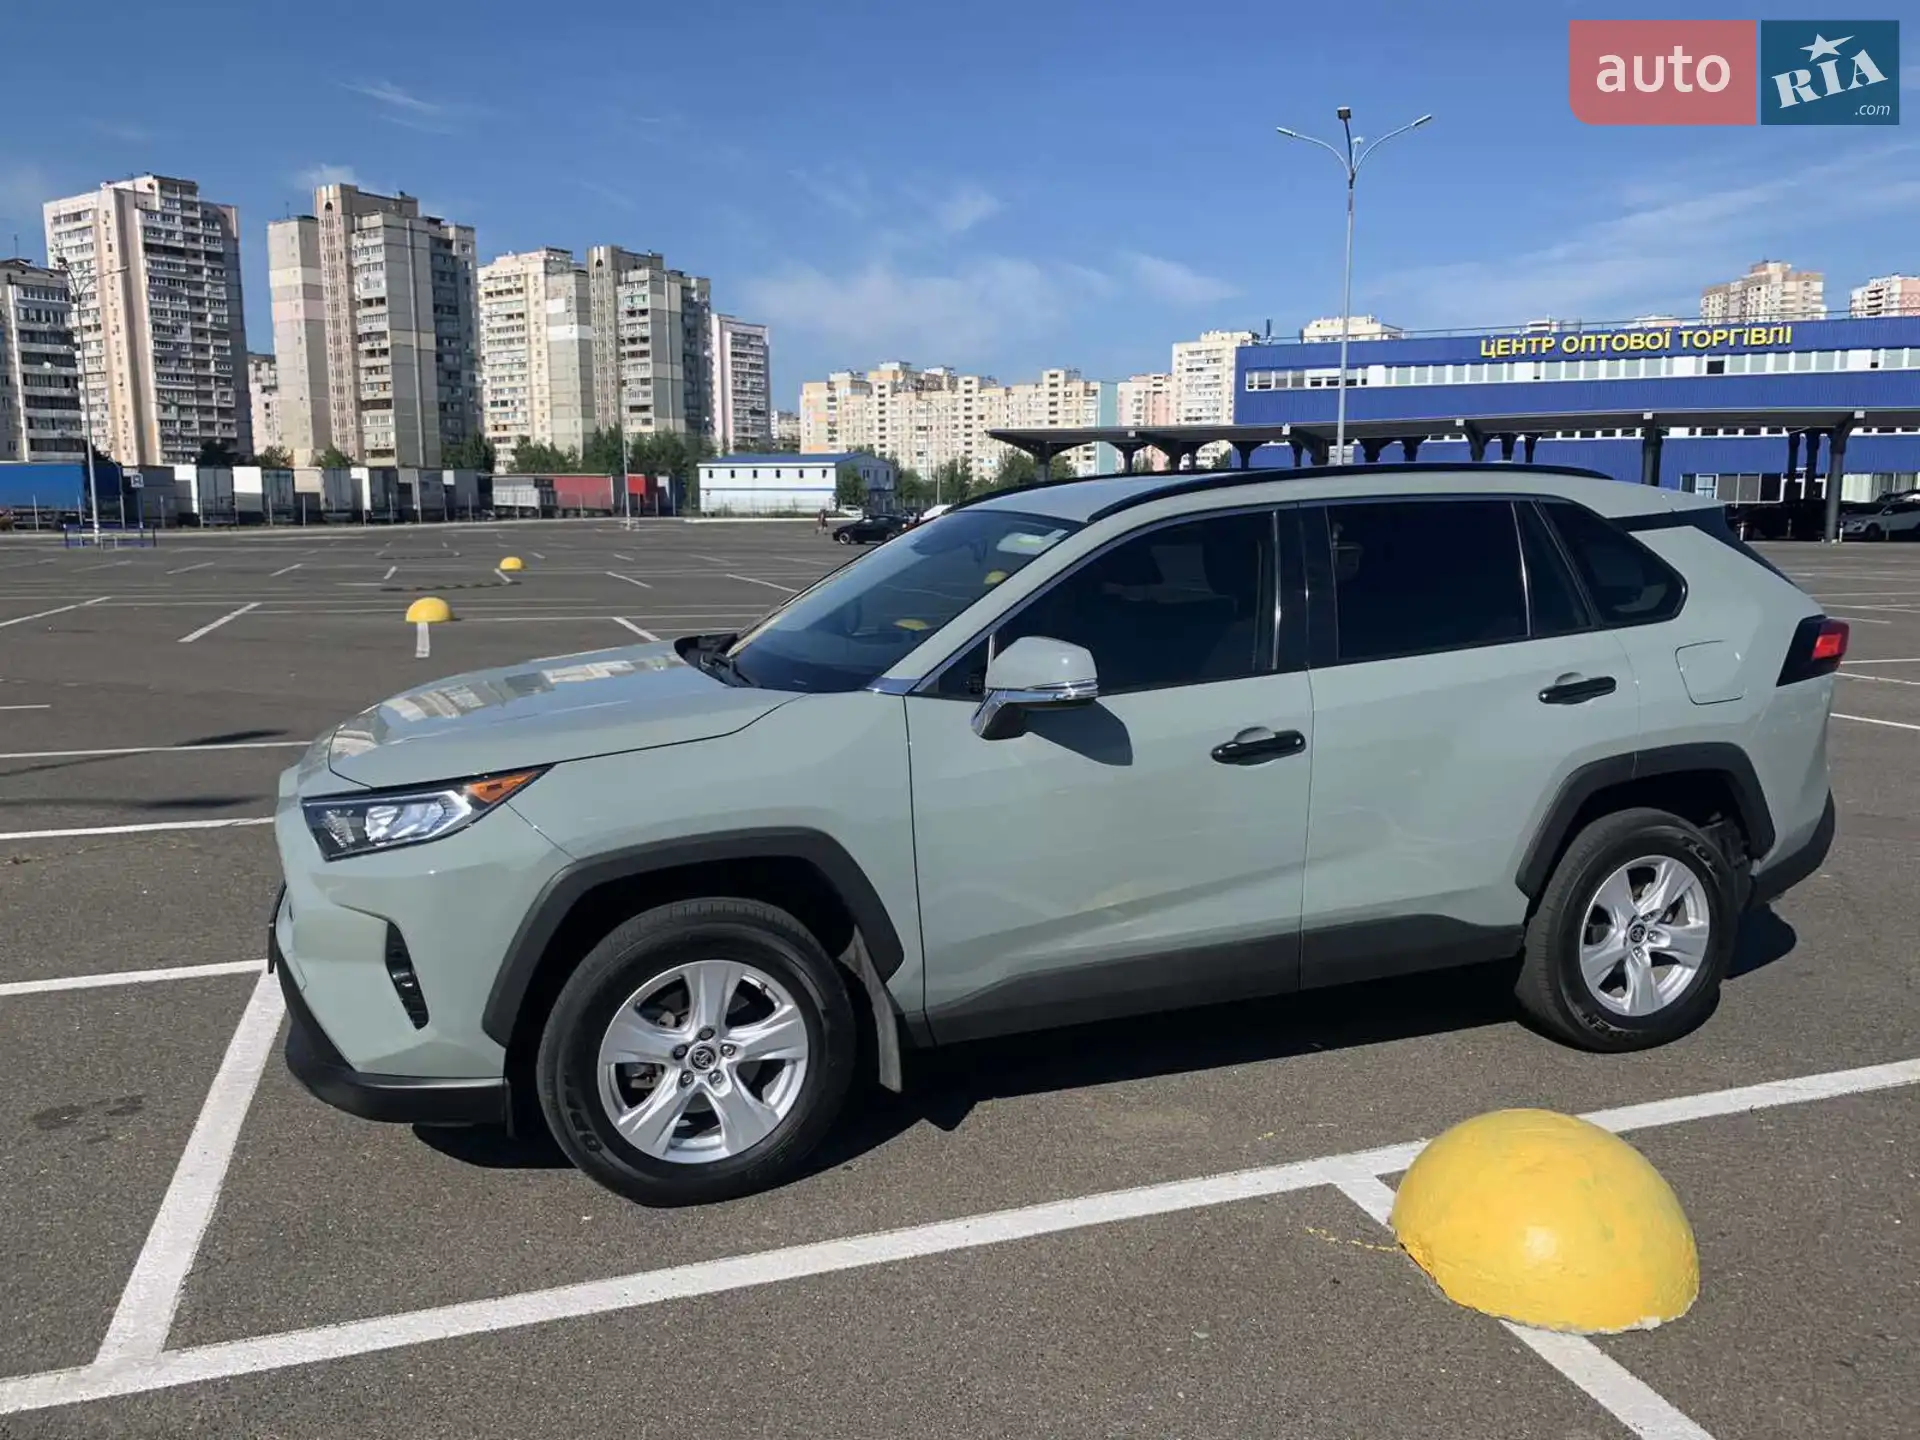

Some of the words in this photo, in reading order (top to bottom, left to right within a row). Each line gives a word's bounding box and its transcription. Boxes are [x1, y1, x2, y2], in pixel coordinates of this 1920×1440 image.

[1480, 336, 1555, 358] ЦЕНТР
[1561, 327, 1671, 354] ОПТОВОЇ
[1678, 325, 1793, 349] ТОРГІВЛІ
